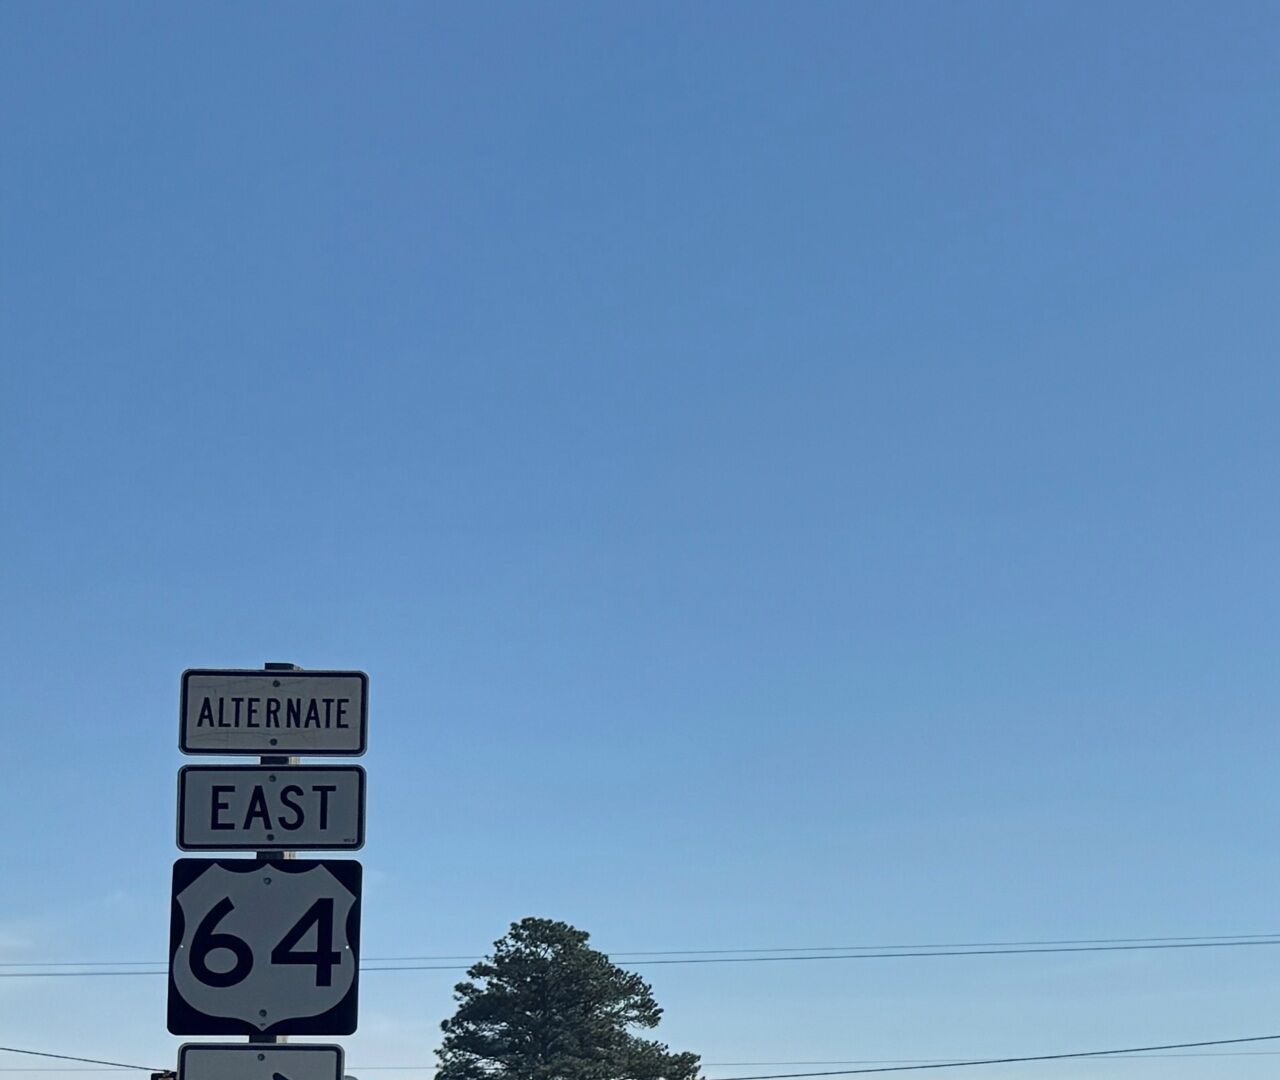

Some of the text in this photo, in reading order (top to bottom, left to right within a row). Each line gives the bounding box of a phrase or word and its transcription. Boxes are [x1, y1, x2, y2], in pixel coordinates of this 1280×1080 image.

[197, 697, 349, 728] ALTERNATE
[210, 785, 337, 830] EAST
[189, 896, 341, 988] 64
